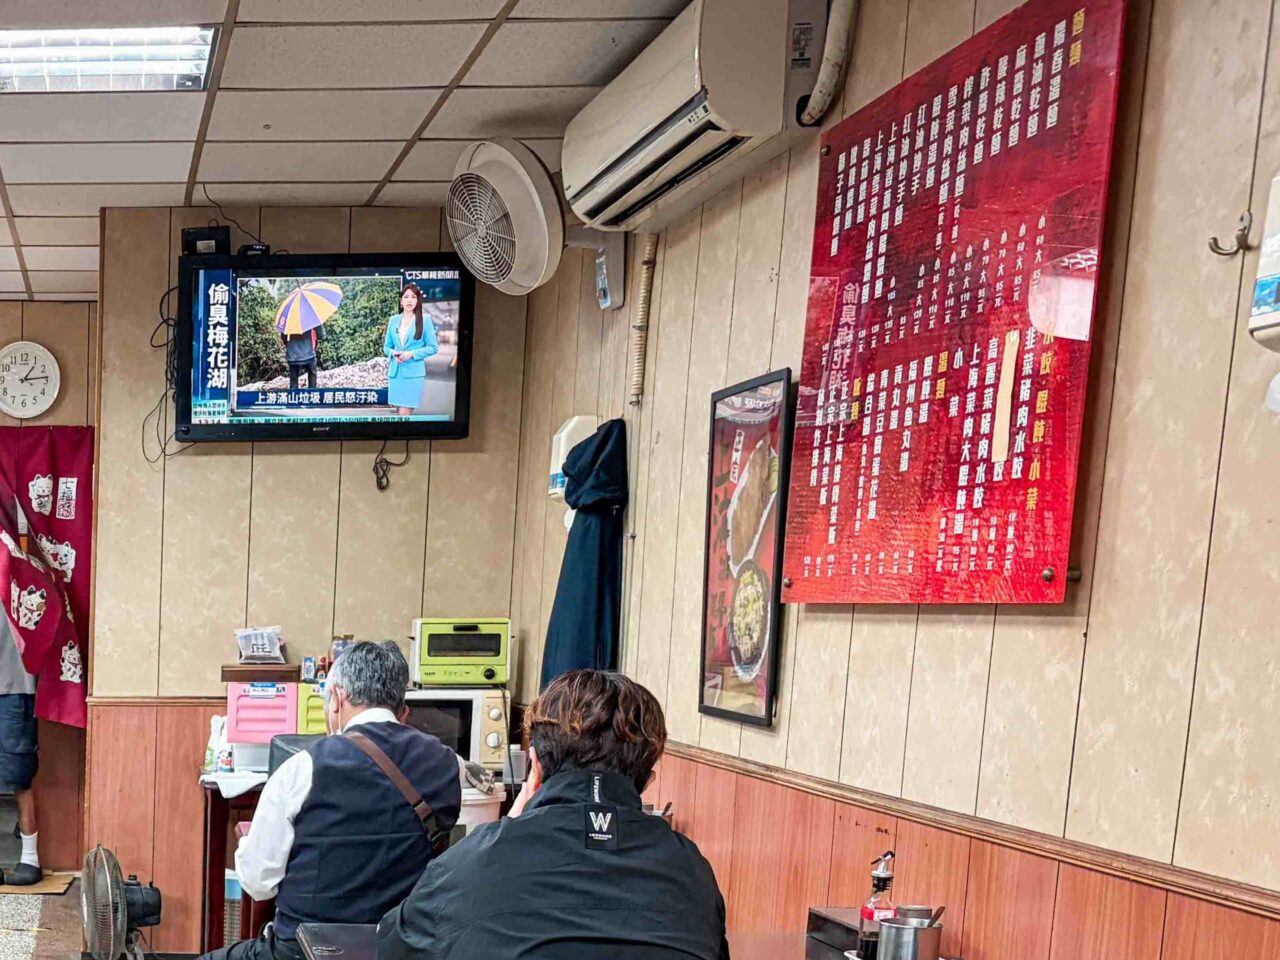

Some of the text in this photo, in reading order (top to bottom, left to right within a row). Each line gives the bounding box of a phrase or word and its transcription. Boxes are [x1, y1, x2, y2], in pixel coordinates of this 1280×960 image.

[1007, 44, 1026, 148] 麻醬乾麵
[910, 104, 925, 197] 紅油抄手
[894, 113, 911, 226] 紅油抄手麵
[207, 283, 229, 389] 偷臭梅花湖
[10, 356, 17, 365] 11
[20, 353, 29, 362] 12
[34, 356, 37, 364] 1
[2, 364, 10, 372] 10
[41, 364, 46, 373] 2
[0, 376, 4, 384] 9
[3, 388, 8, 396] 8
[40, 388, 45, 396] 4
[918, 357, 932, 423] 餛飩湯
[11, 396, 16, 404] 7
[21, 399, 26, 408] 6
[32, 396, 37, 404] 5
[255, 391, 321, 404] 上游滿山垃圾
[889, 366, 902, 430] 貢丸湯
[1011, 326, 1036, 479] 韭菜豬肉水餃
[899, 361, 917, 471] 福州魚丸湯
[972, 337, 998, 508] 高麗菜豬肉水餃
[953, 343, 980, 534] 上海菜肉大餛飩湯
[589, 811, 612, 832] W
